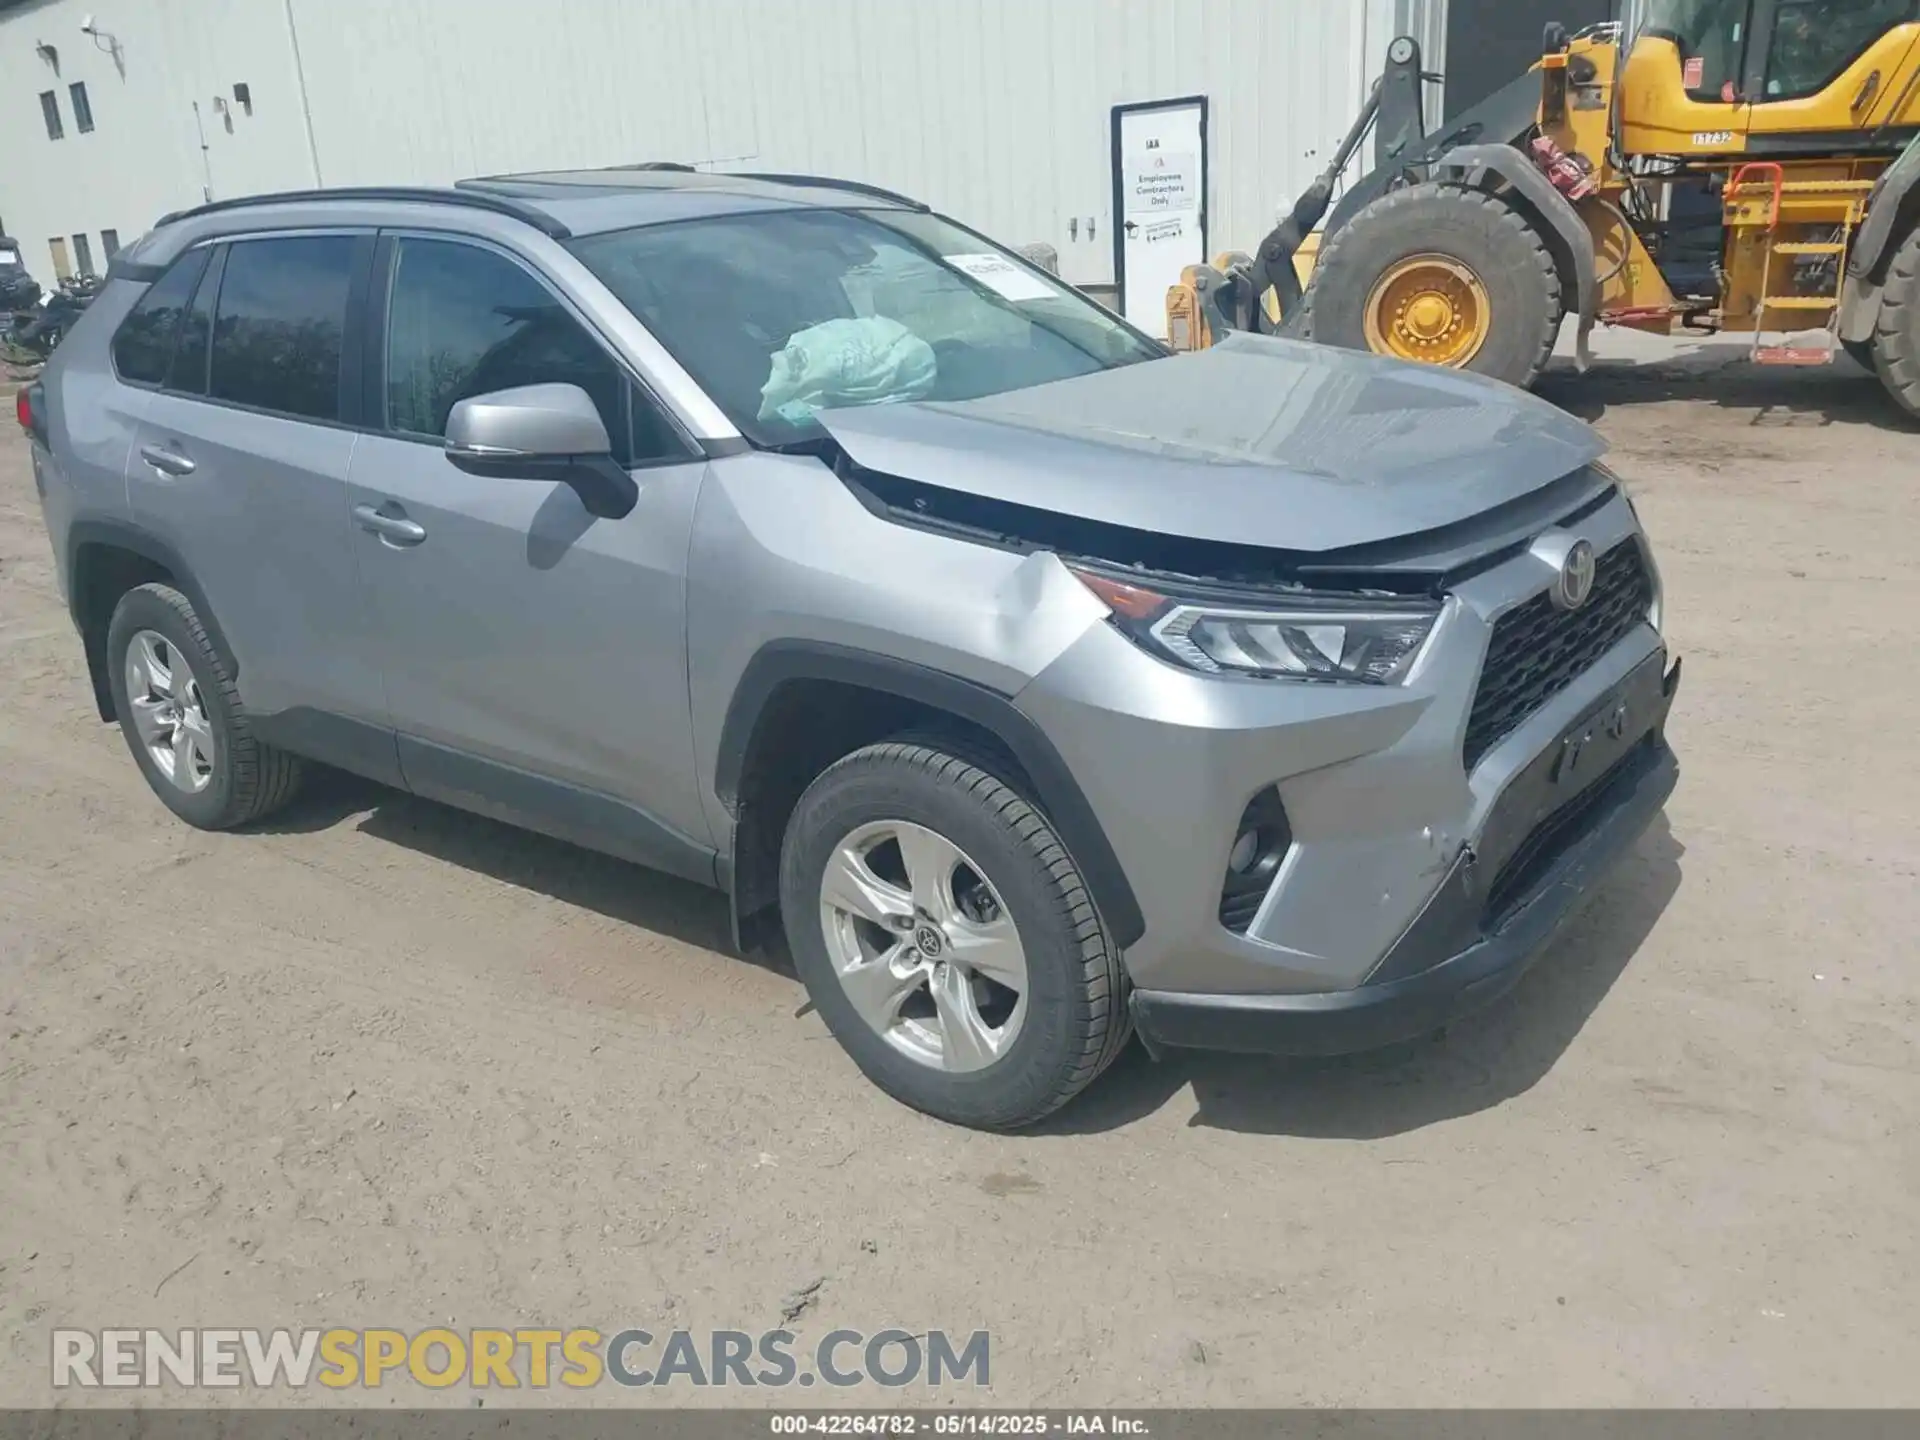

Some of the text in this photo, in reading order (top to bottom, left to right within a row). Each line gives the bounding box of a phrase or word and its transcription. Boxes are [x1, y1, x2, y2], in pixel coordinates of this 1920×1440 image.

[1145, 138, 1160, 150] IAA
[1136, 185, 1184, 195] Contractors
[1151, 196, 1169, 206] Only
